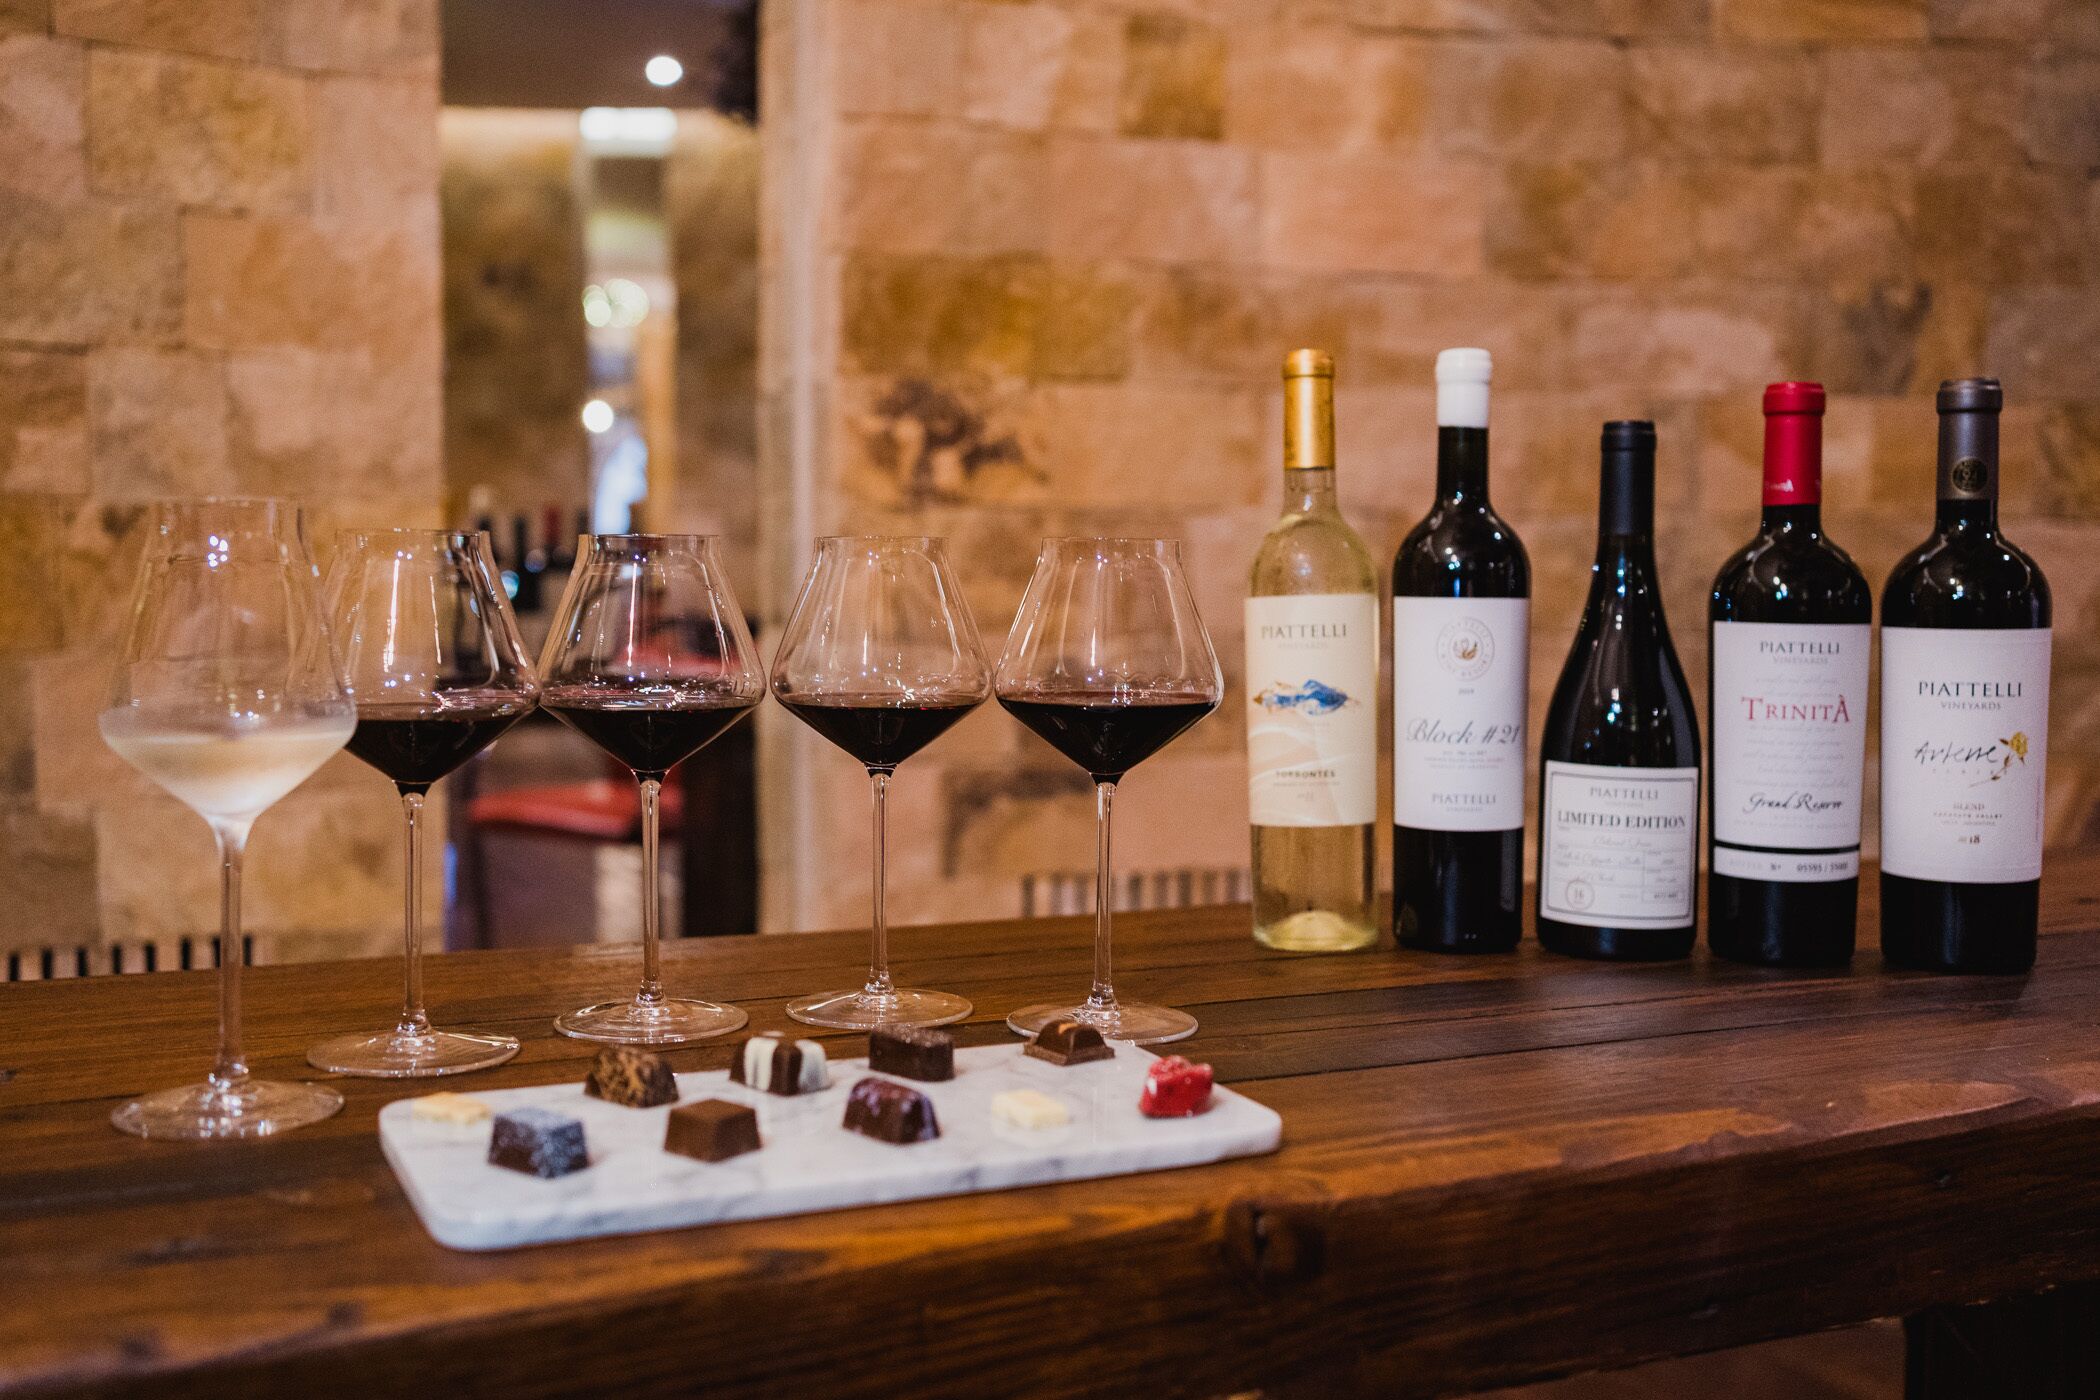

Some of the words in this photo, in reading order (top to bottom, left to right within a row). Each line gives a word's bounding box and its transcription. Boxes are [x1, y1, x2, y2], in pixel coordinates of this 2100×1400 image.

[1261, 623, 1347, 639] PIATTELLI
[1759, 641, 1840, 655] PIATTELLI
[1918, 681, 2022, 697] PIATTELLI
[1941, 701, 2002, 710] VINEYARDS
[1406, 718, 1475, 744] Block
[1481, 724, 1521, 744] #21
[1432, 791, 1497, 805] PIATTELLI
[1590, 786, 1659, 800] PIATTELLI
[1742, 790, 1798, 814] Grand
[1558, 810, 1621, 827] LIMITED
[1625, 815, 1686, 830] EDITION
